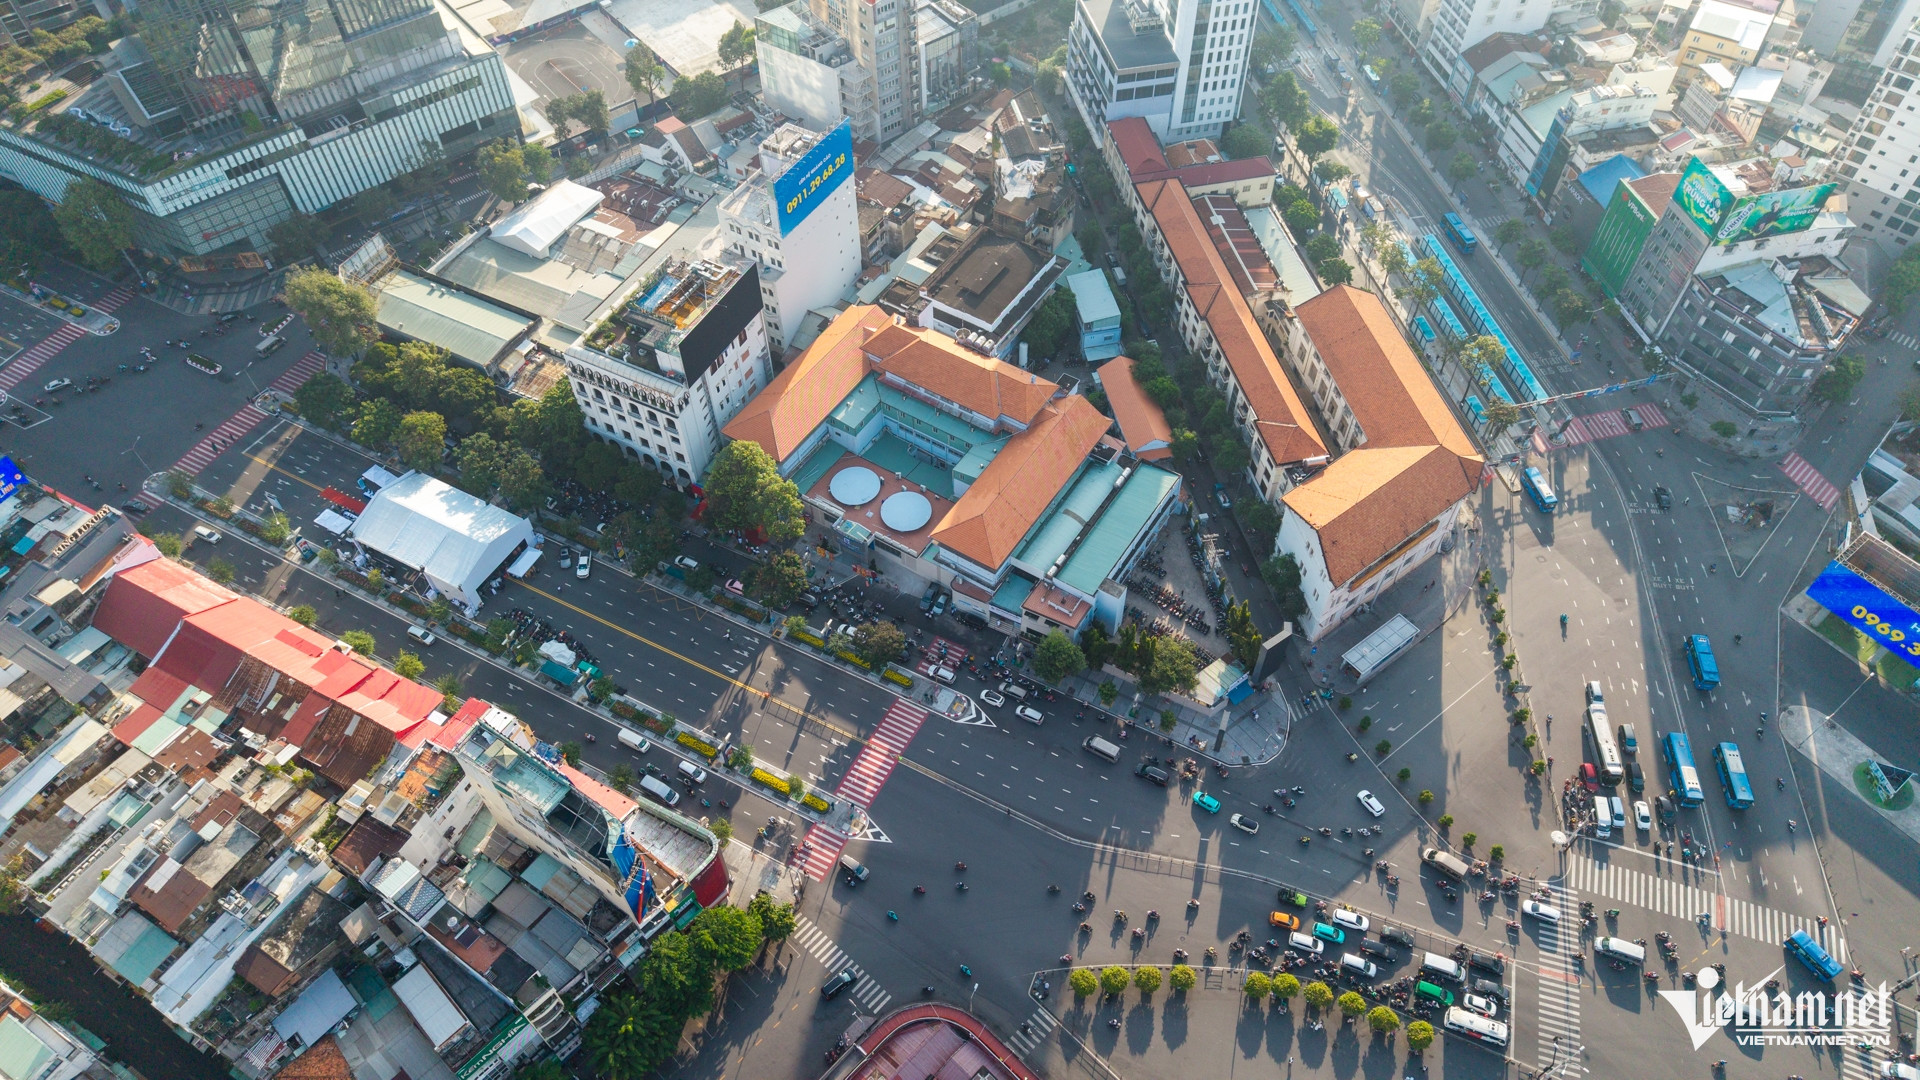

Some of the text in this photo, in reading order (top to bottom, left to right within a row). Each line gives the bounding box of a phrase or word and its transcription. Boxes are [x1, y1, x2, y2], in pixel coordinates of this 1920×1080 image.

[786, 153, 846, 214] 0911.29.68.28
[1627, 199, 1646, 223] VPBank
[1719, 202, 1754, 237] TUBORG
[52, 533, 77, 557] KING
[77, 505, 111, 540] LUXURY
[1851, 605, 1920, 656] 0969.3
